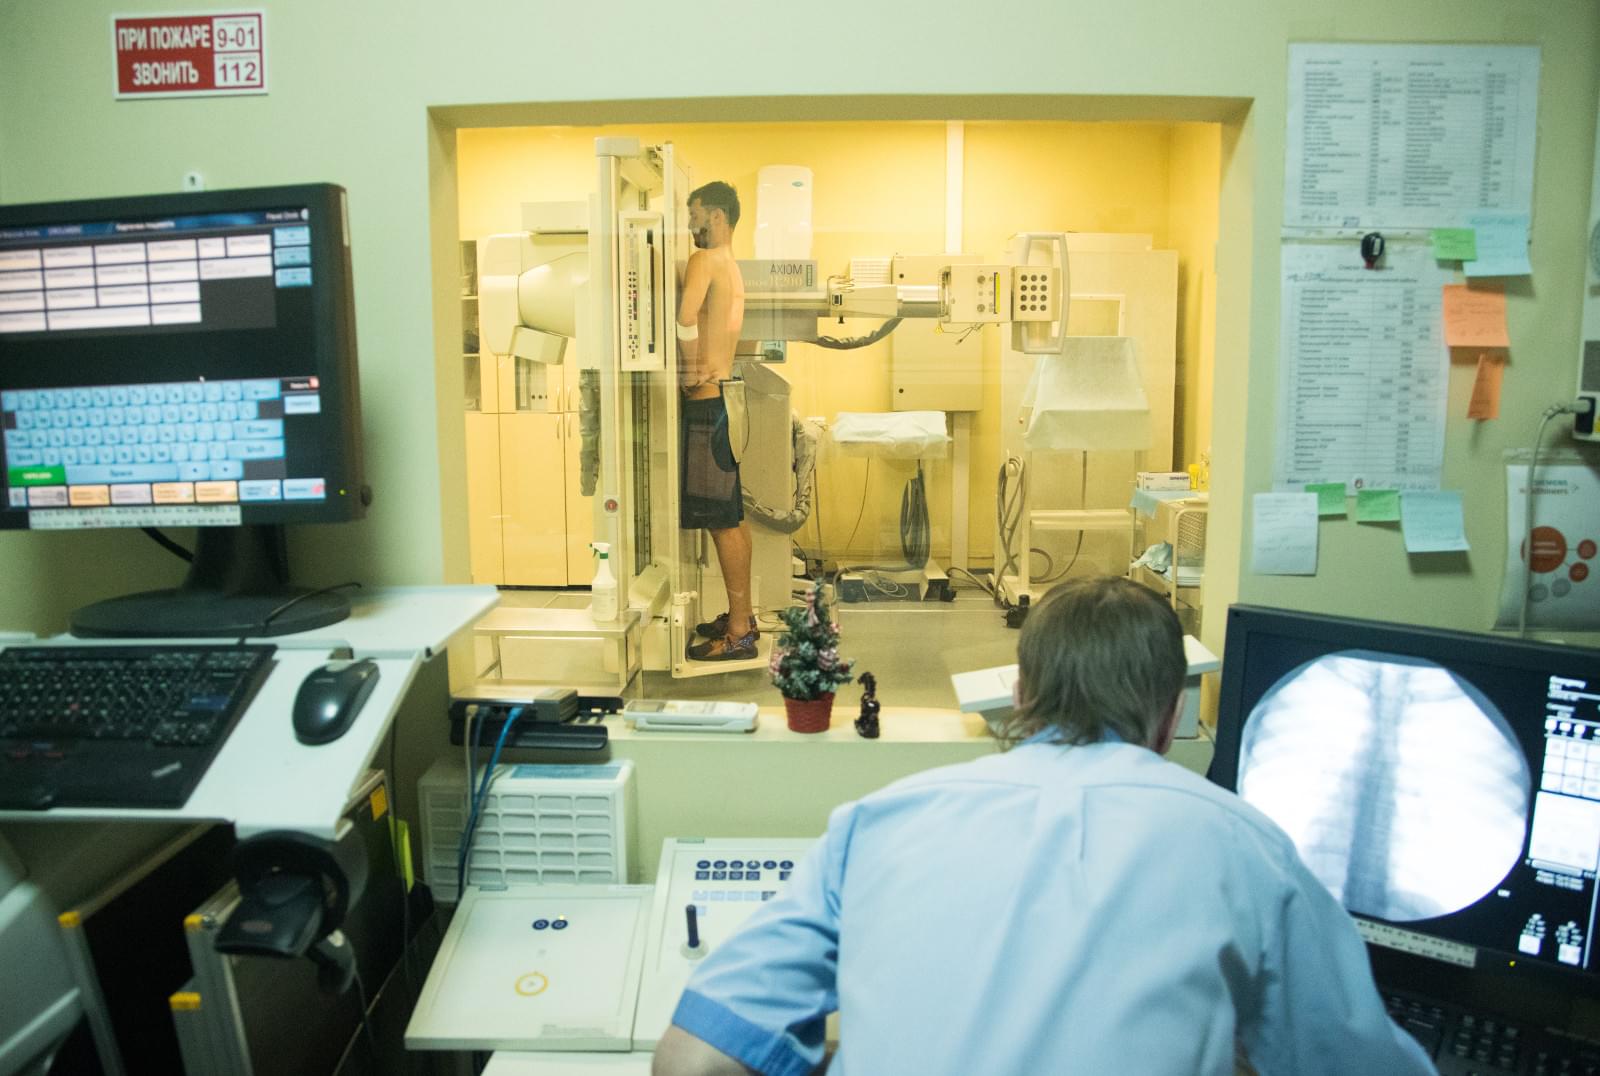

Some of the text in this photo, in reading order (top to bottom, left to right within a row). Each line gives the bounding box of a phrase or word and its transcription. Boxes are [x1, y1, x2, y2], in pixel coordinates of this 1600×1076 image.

[118, 24, 210, 50] ПРИ ПОЖАРЕ
[217, 27, 255, 48] 9-01
[132, 60, 199, 86] ЗВОНИТЬ
[218, 61, 257, 82] 112
[770, 263, 802, 275] AXIOM
